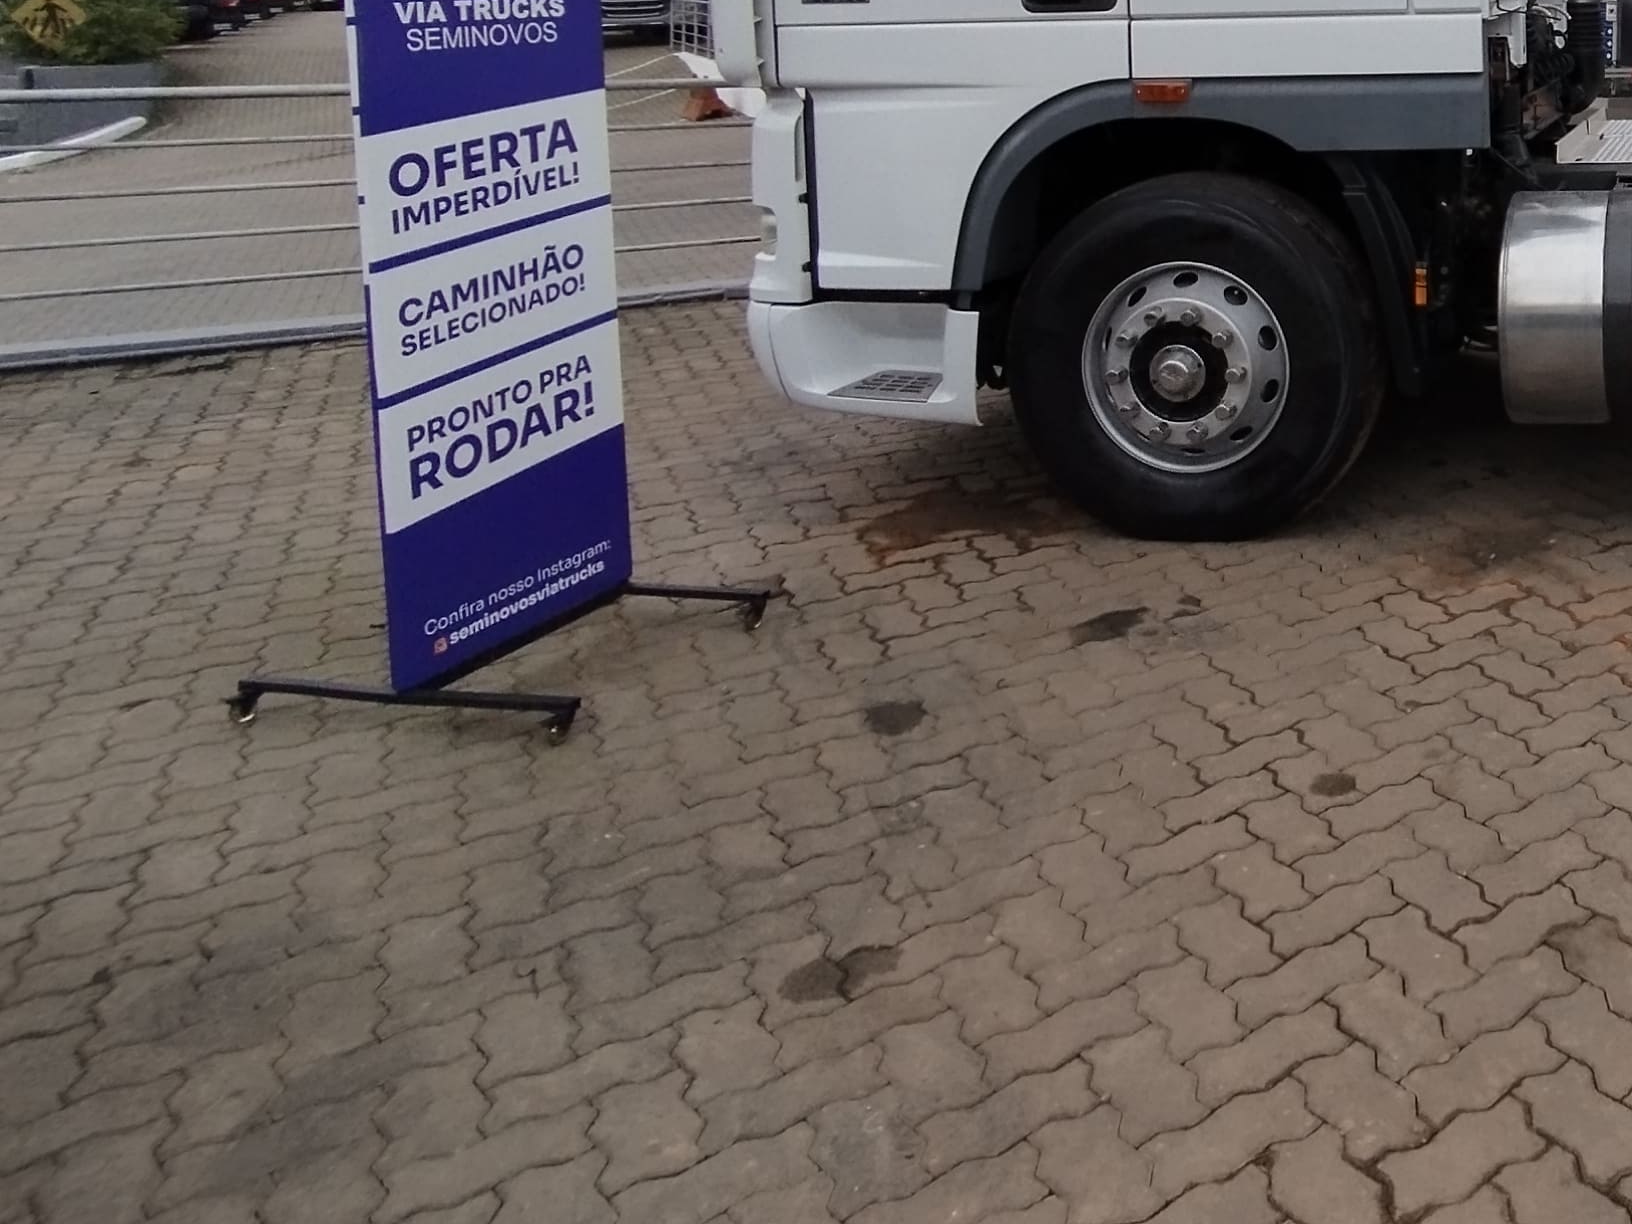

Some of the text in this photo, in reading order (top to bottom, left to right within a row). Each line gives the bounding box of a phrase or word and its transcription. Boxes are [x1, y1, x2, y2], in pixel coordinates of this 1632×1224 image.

[393, 0, 447, 25] VIA
[406, 21, 559, 52] SEMINOVOS
[388, 117, 579, 197] OFERTA
[391, 161, 580, 235] IMPERDÍVEL!
[397, 243, 585, 327] CAMINHÃO
[400, 272, 586, 357] SELECIONADO!
[406, 354, 593, 453] PRONTO PRA
[408, 380, 596, 501] RODAR!
[424, 539, 612, 635] Confira nosso Instagram:
